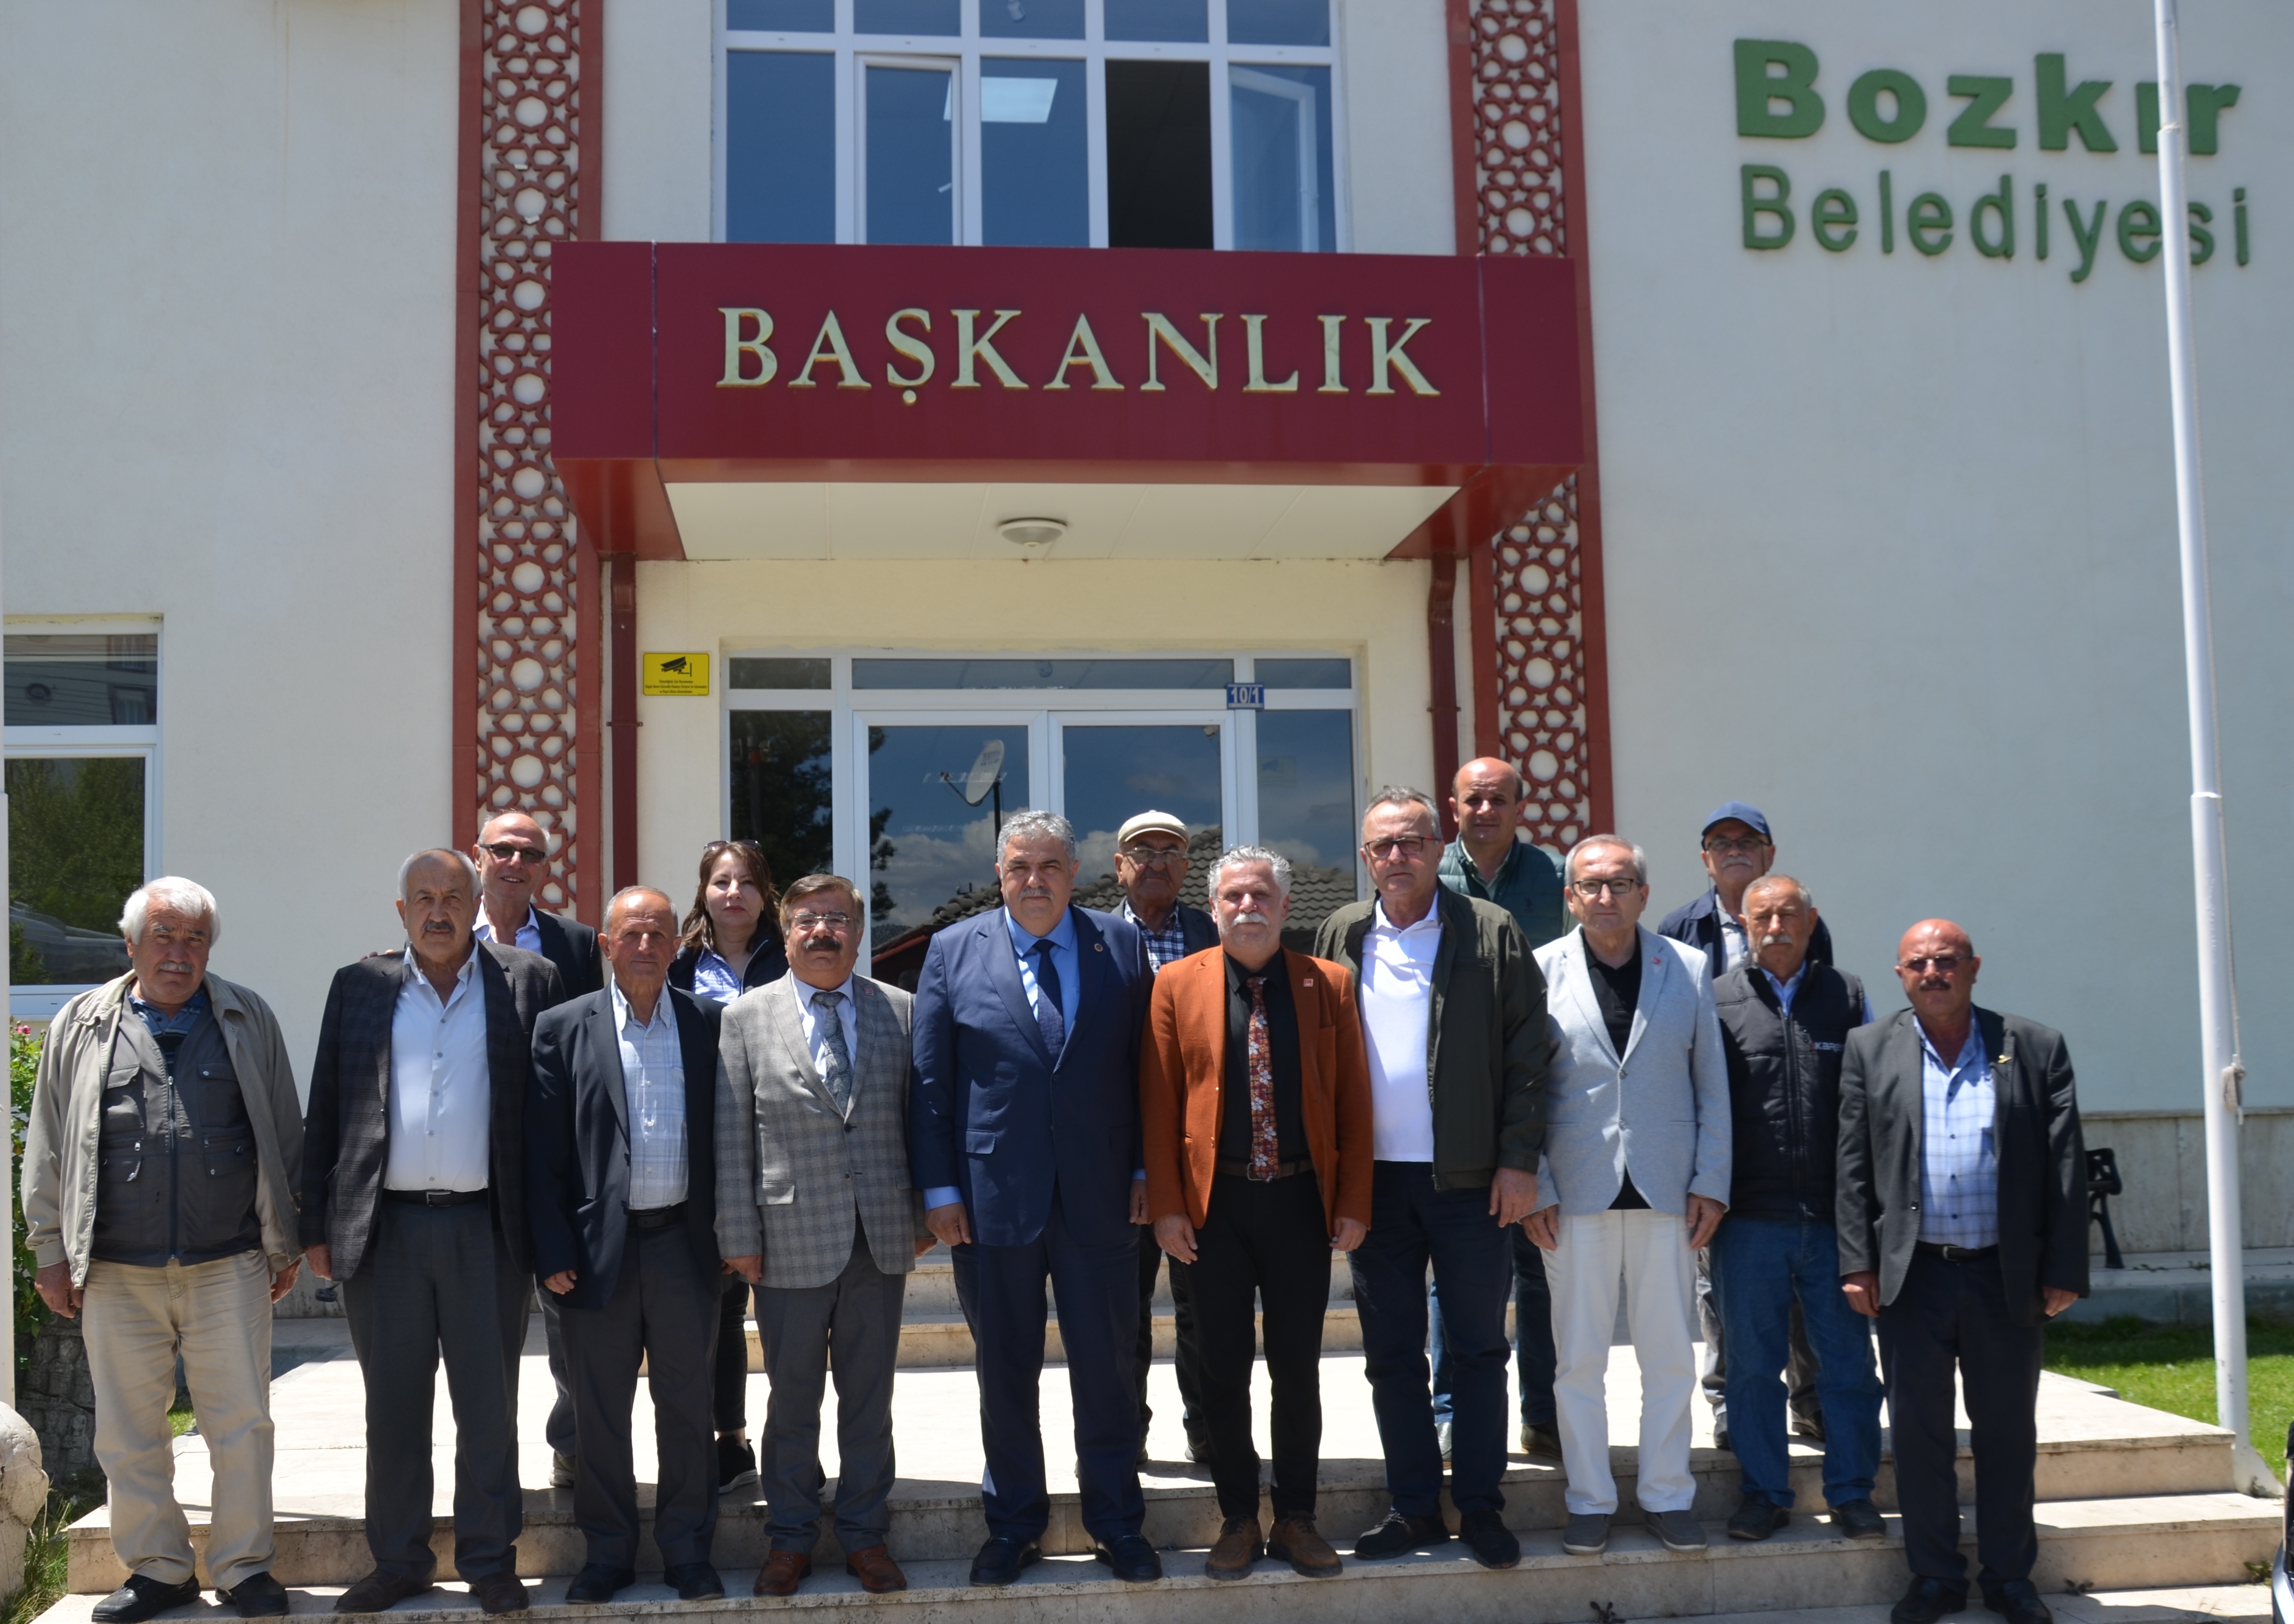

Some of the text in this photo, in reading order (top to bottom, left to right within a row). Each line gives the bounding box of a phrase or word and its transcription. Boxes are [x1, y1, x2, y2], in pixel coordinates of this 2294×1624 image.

[1734, 38, 2242, 157] Bozkır
[1741, 163, 2251, 285] Belediyesi
[716, 307, 1442, 405] BAŞKANLIK
[1231, 687, 1259, 704] 10/1
